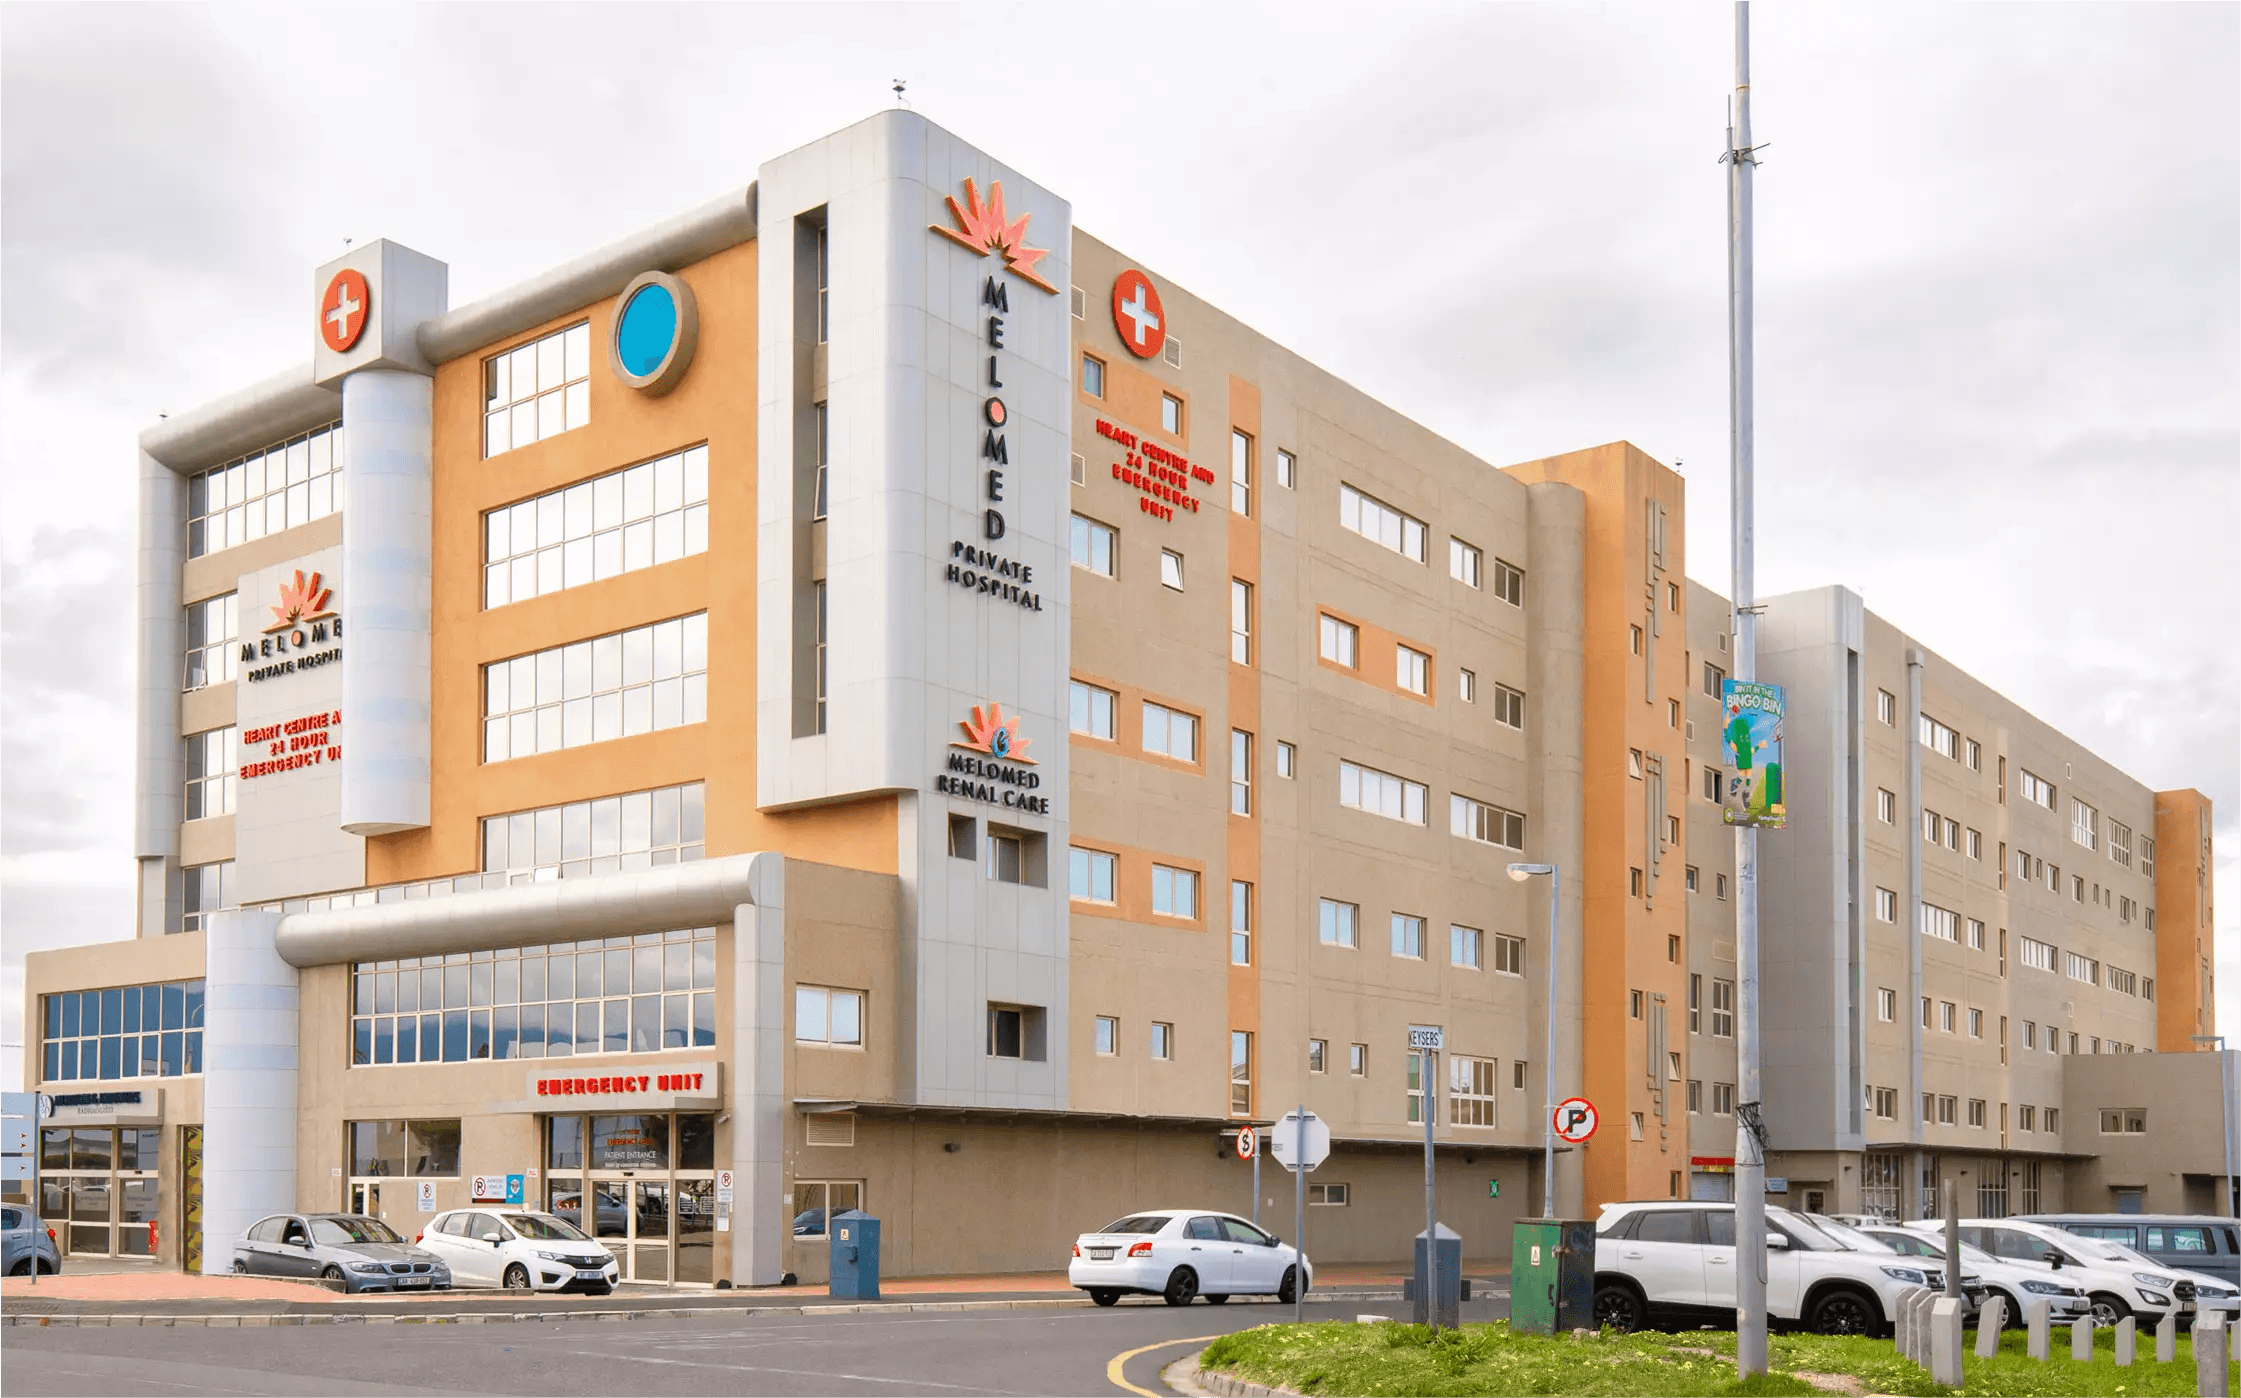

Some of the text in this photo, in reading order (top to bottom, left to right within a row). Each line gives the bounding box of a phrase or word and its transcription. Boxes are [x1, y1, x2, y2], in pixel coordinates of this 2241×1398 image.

[985, 276, 1009, 540] MELOMED
[1096, 418, 1215, 485] HEART CENTRE AND
[1112, 463, 1199, 512] EMERGENCY
[1126, 451, 1187, 490] 24 HOUR
[1140, 497, 1173, 522] UNIT
[953, 540, 1032, 583] PRIVATE
[946, 563, 1042, 611] HOSPITAL
[241, 618, 342, 662] MELOME
[248, 648, 342, 682] PRIVATE HOSPIT
[1726, 694, 1781, 716] BINGO BIN
[244, 723, 281, 745] HEART
[283, 712, 329, 736] CENTRE
[269, 731, 328, 756] 24 HOUR
[240, 749, 322, 779] EMERGENCY
[949, 753, 1040, 789] MELOMED
[938, 774, 1049, 814] RENAL CARE
[1409, 1030, 1439, 1046] KEYSERS
[536, 1073, 704, 1096] EMERGENCY UNIT
[1568, 1110, 1587, 1133] P
[604, 1151, 656, 1159] PATIENT ENTRANCE
